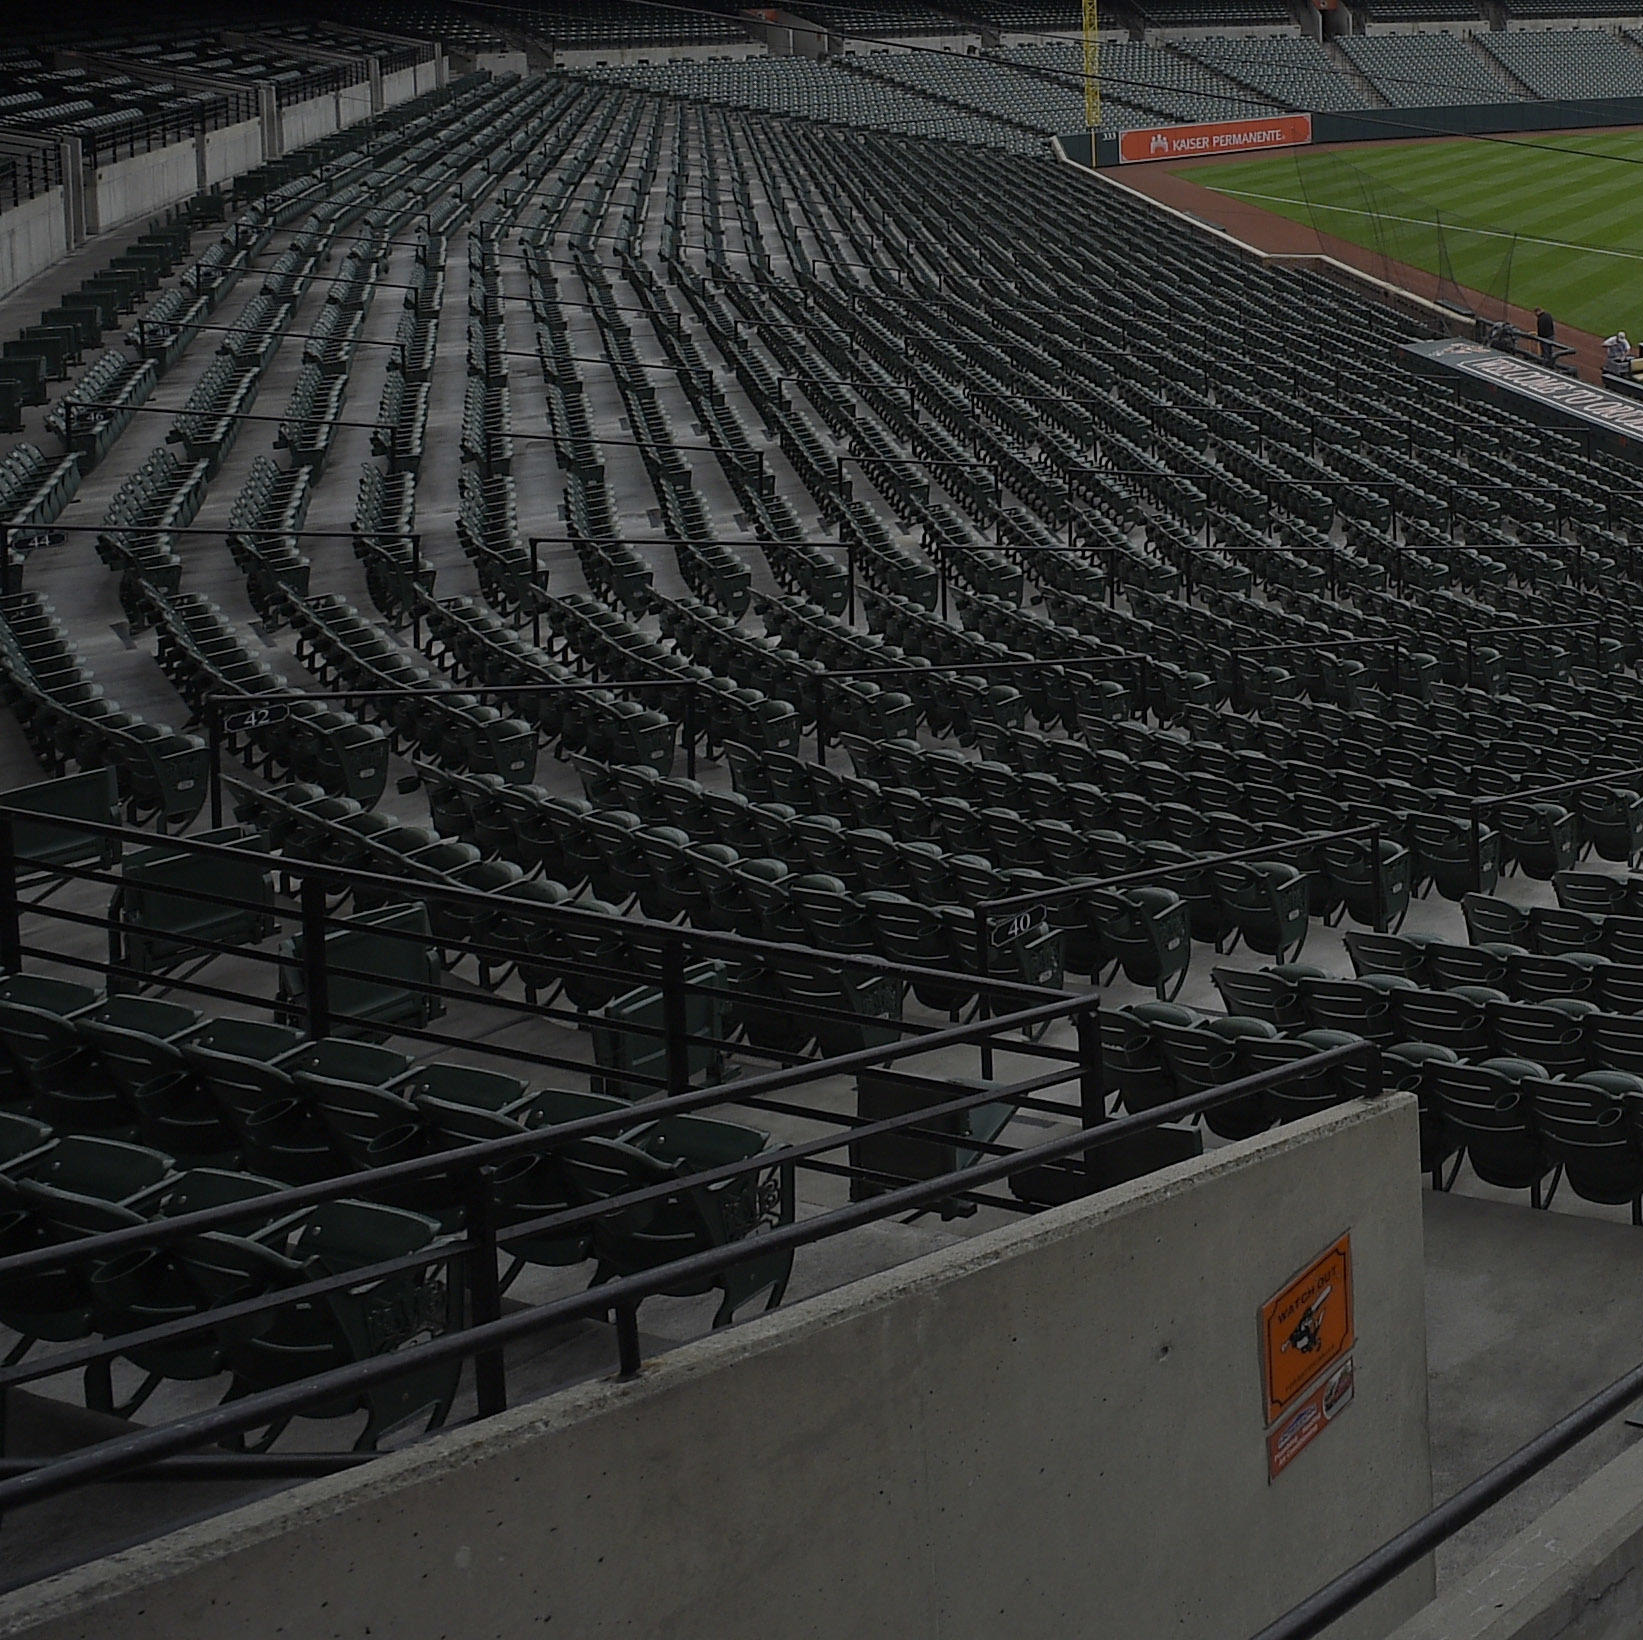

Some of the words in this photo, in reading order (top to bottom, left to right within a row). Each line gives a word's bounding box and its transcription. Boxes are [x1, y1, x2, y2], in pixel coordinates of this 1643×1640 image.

[1172, 137, 1210, 152] KAISER
[1212, 129, 1284, 147] PERMANENTE
[1471, 358, 1577, 394] WELCOME
[1552, 389, 1604, 406] TO
[87, 412, 105, 422] 46
[28, 534, 50, 548] 44
[243, 709, 271, 727] 42
[1007, 912, 1031, 937] 40
[1277, 1287, 1316, 1325] WATCH
[1316, 1265, 1338, 1290] OUT
